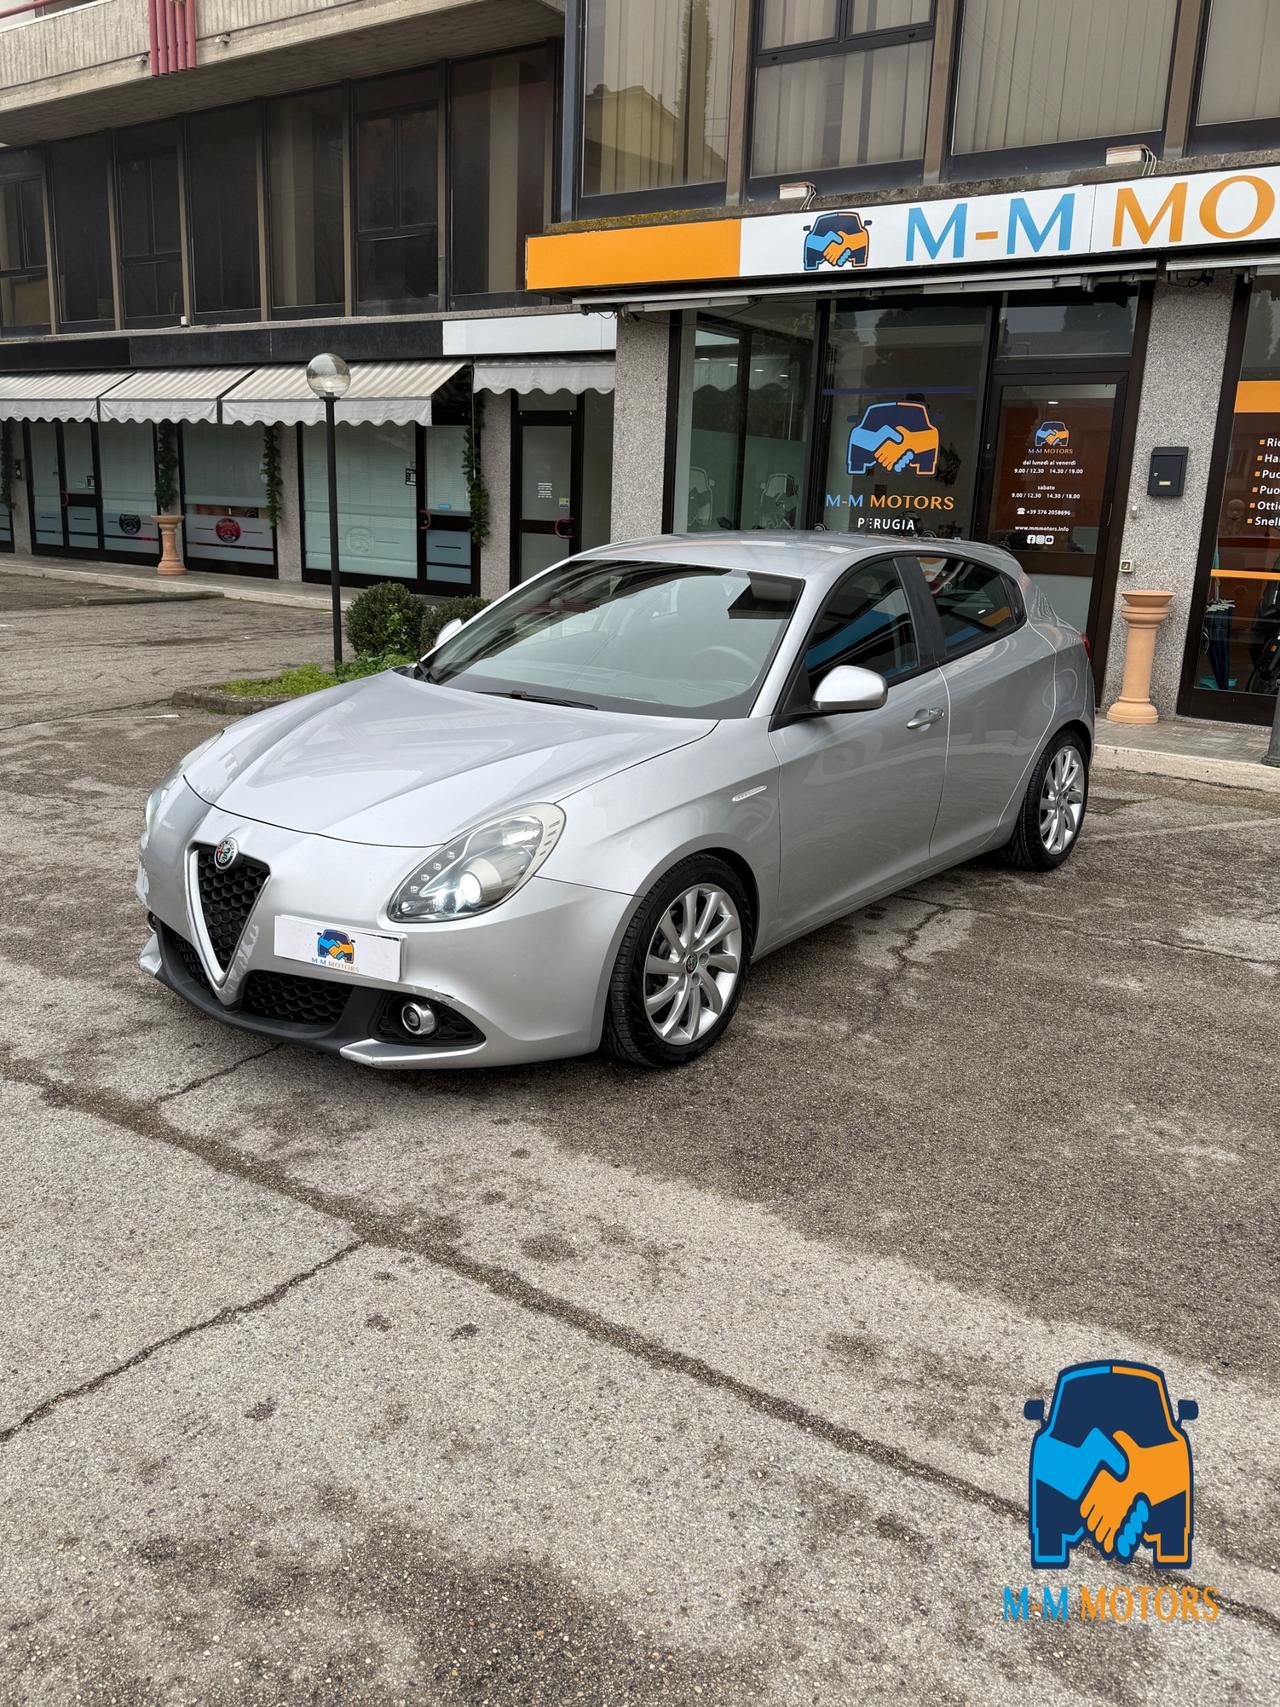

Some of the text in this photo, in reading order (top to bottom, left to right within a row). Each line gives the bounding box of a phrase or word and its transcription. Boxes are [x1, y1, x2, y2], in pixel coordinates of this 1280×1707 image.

[905, 193, 1076, 262] M-M
[1264, 454, 1280, 463] Ha
[826, 494, 954, 510] M-M MOTORS
[1257, 501, 1280, 511] Otti
[328, 961, 359, 972] MOTORS
